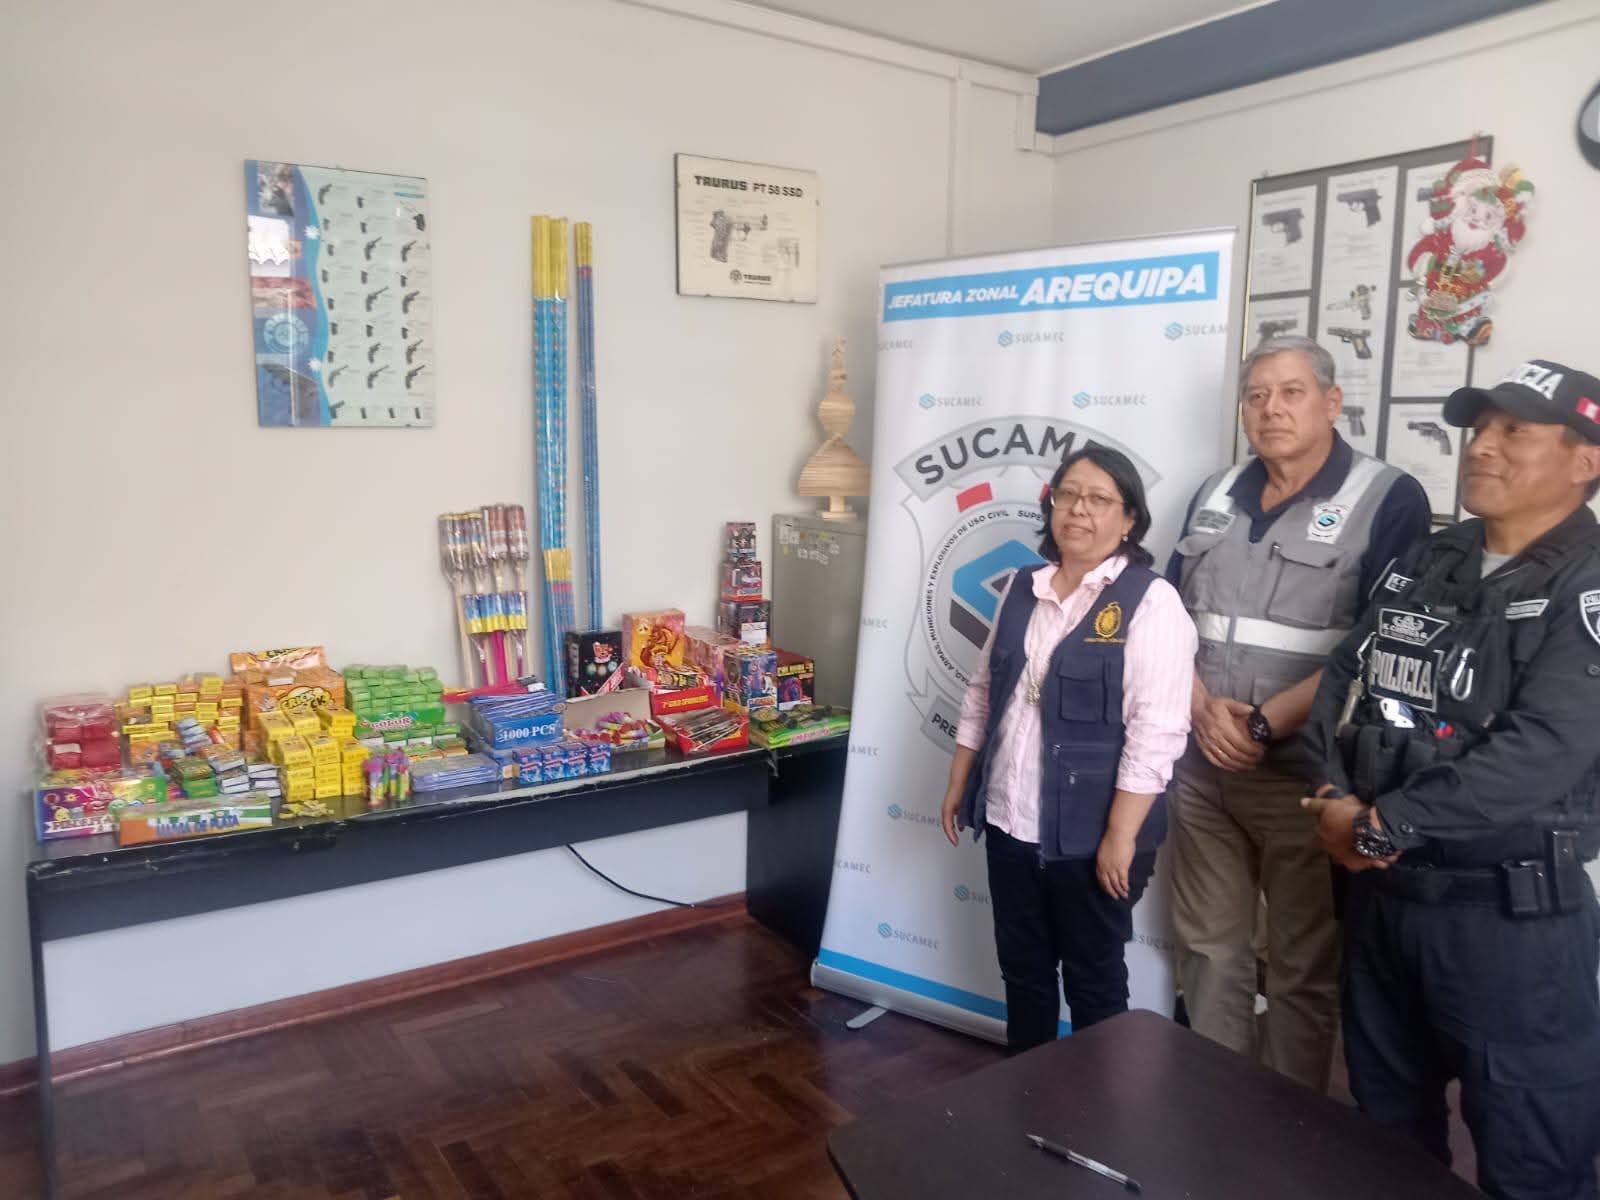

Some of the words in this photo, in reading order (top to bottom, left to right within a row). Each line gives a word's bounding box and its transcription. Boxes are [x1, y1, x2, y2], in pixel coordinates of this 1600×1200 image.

[694, 175, 748, 191] TAURUS
[753, 182, 766, 194] PT
[888, 290, 962, 309] JEFATURA
[965, 286, 1019, 303] ZONAL
[1019, 264, 1207, 306] AREQUIPA
[1015, 331, 1065, 344] SUCAMEC
[937, 396, 983, 408] SUCAMEC
[1094, 394, 1148, 406] SUCAMEC
[915, 423, 1103, 485] SUCAM
[930, 535, 958, 581] EXPLOSIVOS
[968, 515, 986, 528] USO
[987, 510, 1010, 519] CIVIL
[1370, 649, 1433, 701] POLICIA
[503, 727, 530, 742] 1000
[532, 723, 556, 737] PCS
[893, 929, 940, 949] SUCAMEC
